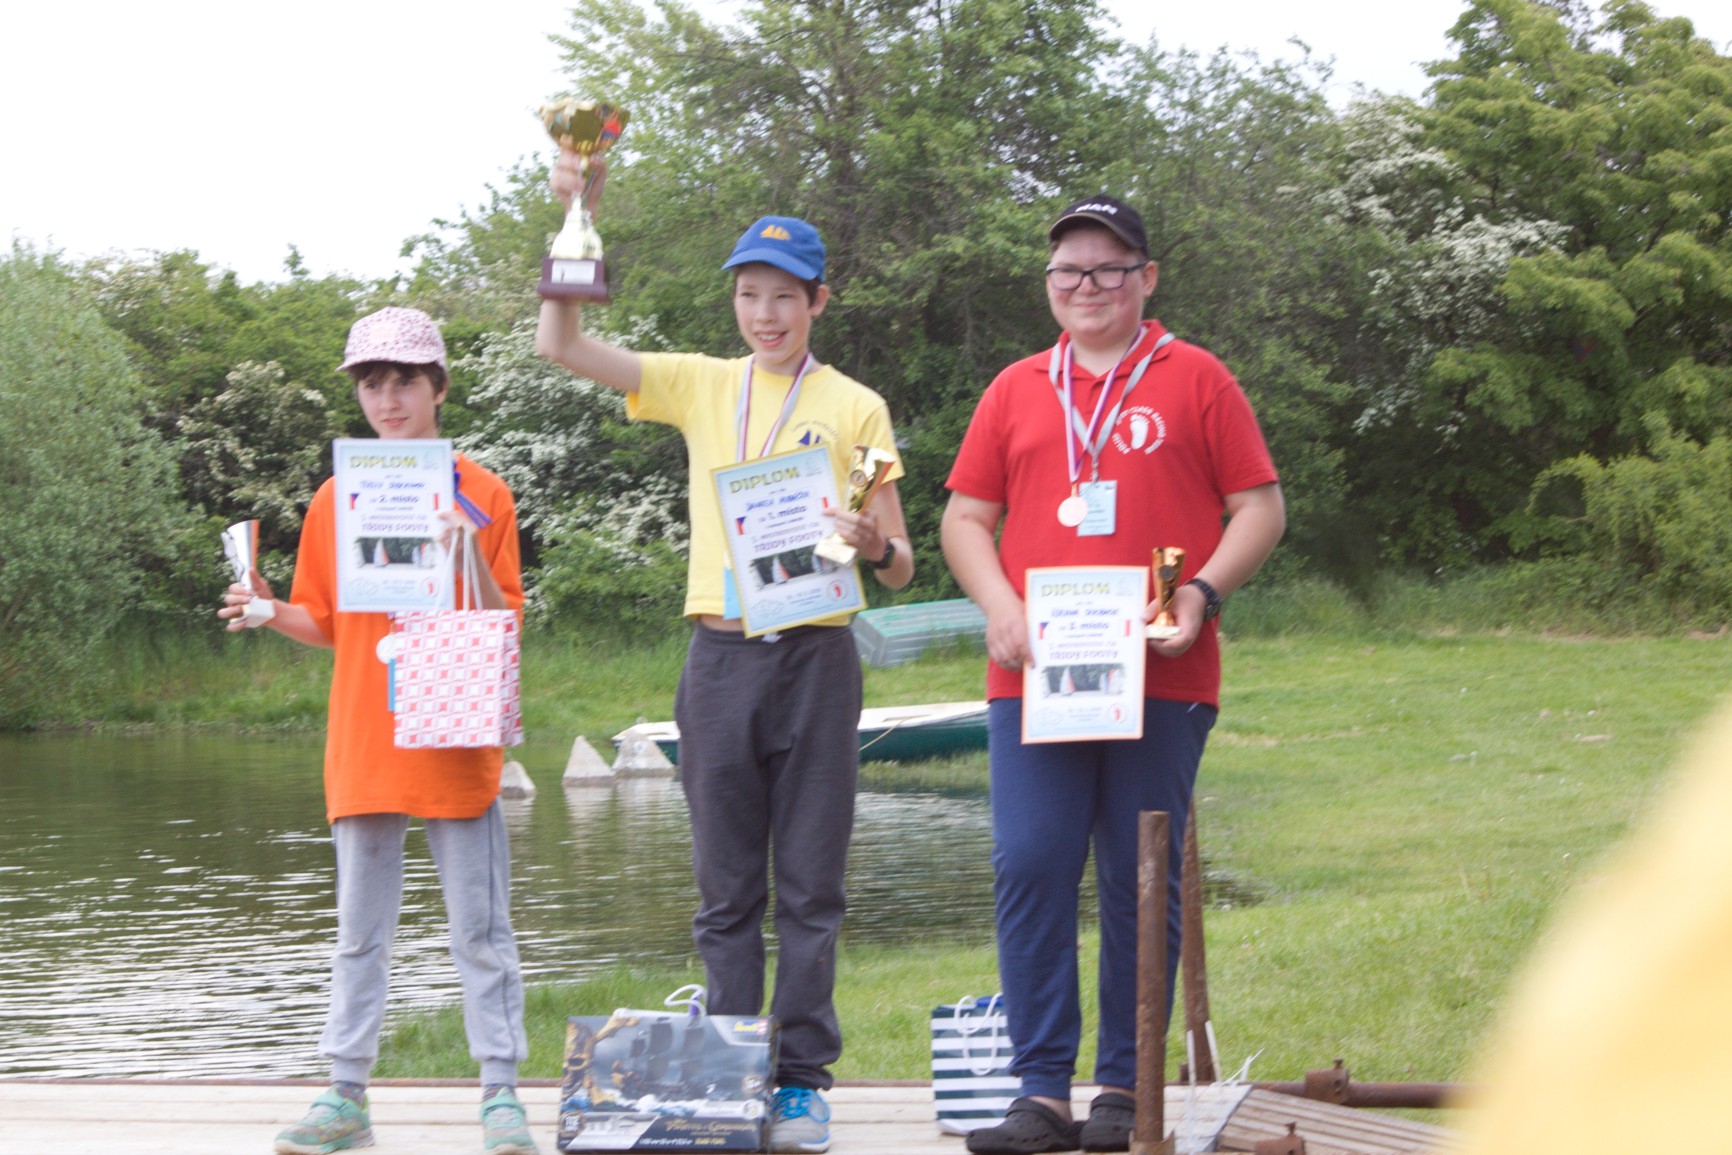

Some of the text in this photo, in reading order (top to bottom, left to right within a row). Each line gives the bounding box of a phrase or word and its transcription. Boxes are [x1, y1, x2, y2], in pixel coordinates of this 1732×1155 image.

[349, 455, 417, 469] DIPLOM
[729, 466, 800, 494] DIPLOM
[1040, 583, 1110, 597] DIPLOM
